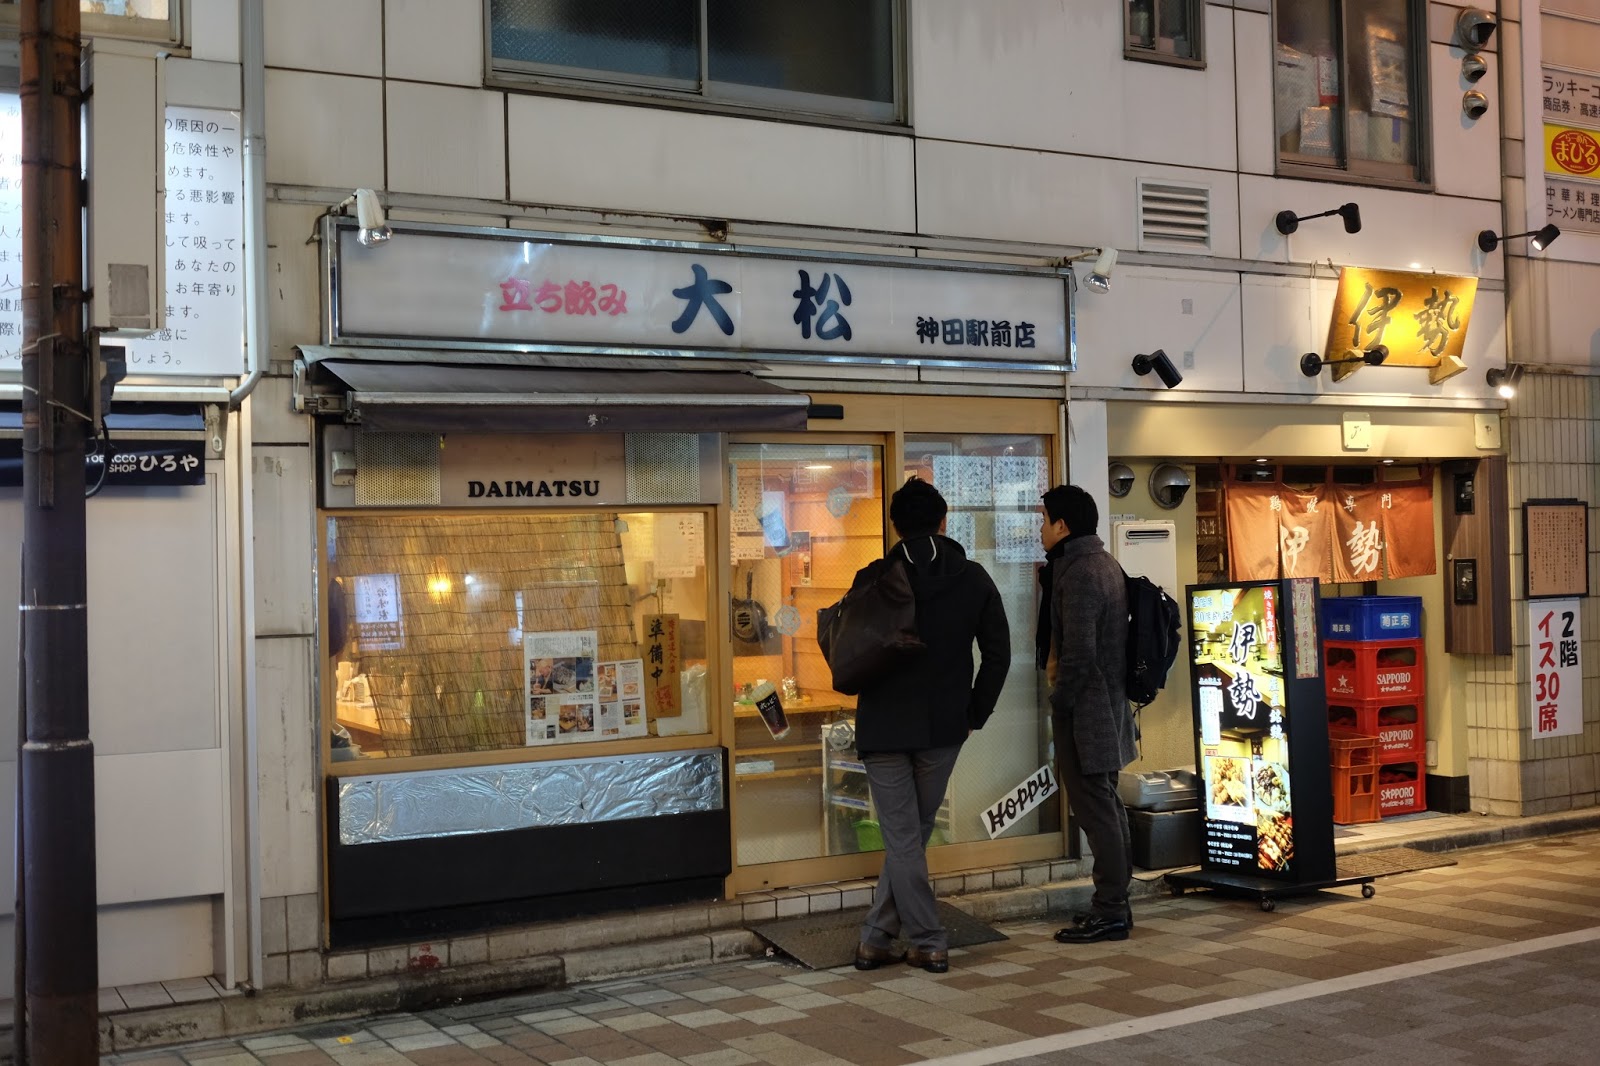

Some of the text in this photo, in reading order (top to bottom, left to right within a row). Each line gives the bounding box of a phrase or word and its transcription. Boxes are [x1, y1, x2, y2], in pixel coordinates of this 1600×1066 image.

[1543, 97, 1600, 119] 商品券・高速
[1555, 141, 1599, 166] まひる
[1546, 186, 1600, 207] 中華料理
[1546, 203, 1600, 223] ラーメン専門店
[499, 263, 1036, 348] 立ち飲み 大松 神田駅前店
[1348, 281, 1461, 357] 伊勢
[109, 464, 136, 472] SHOP
[139, 455, 199, 472] ひろや
[468, 481, 600, 497] DAIMATSU
[1276, 520, 1388, 576] 伊勢
[1382, 614, 1410, 627] 菊正宗
[1560, 611, 1578, 668] 2階
[648, 618, 665, 687] 準備中
[1377, 672, 1411, 685] SAPPORO
[1536, 610, 1560, 732] イス30席
[1379, 729, 1414, 743] SAPPORO
